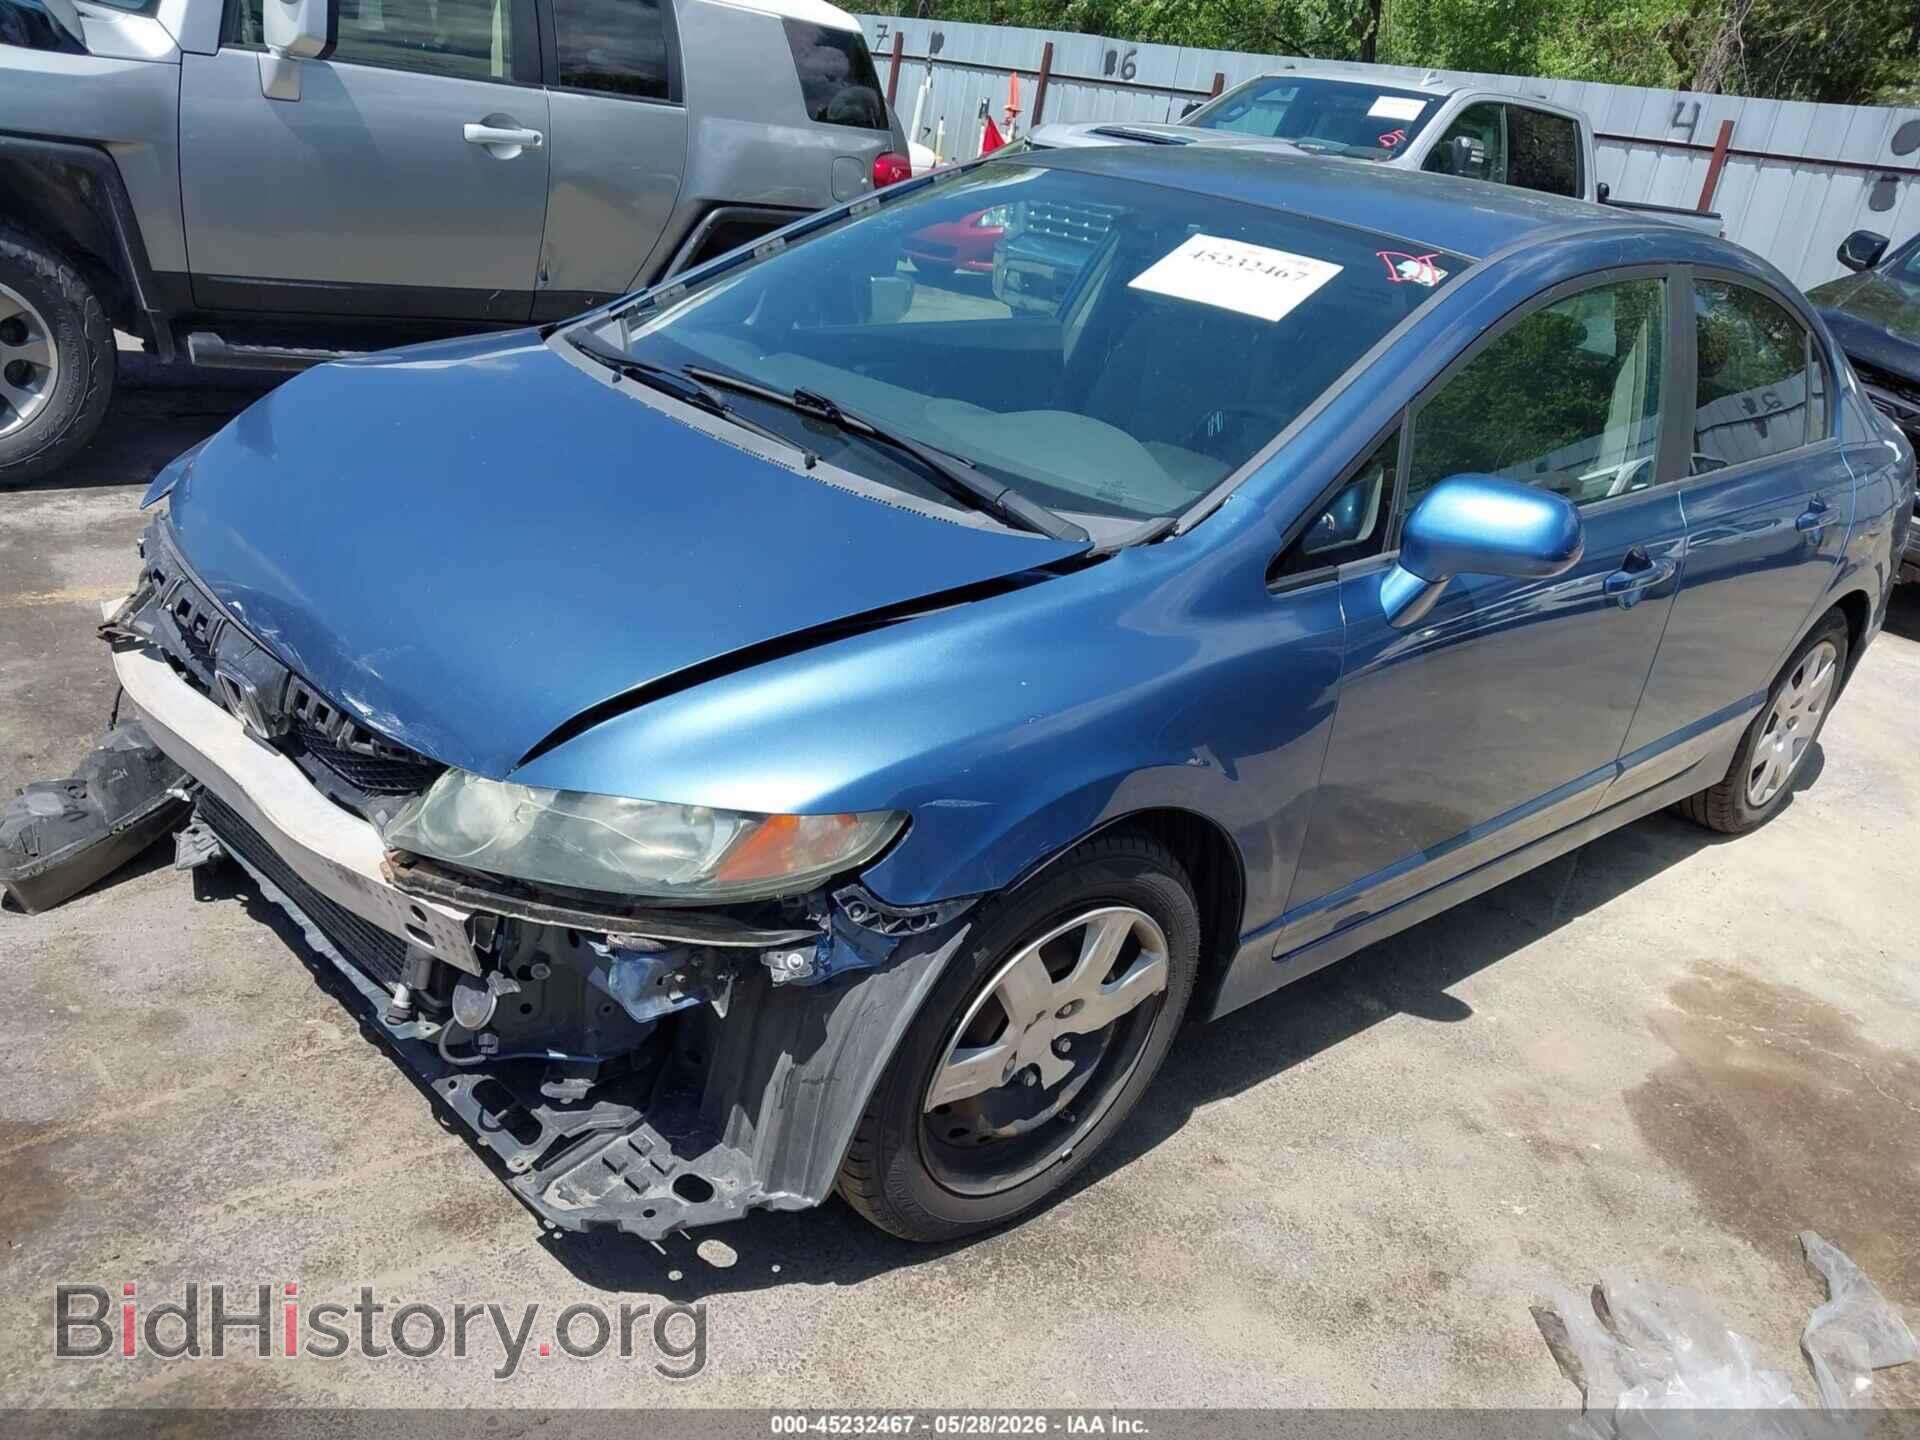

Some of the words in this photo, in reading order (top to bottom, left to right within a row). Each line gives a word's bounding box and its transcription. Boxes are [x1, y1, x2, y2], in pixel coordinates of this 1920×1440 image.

[875, 24, 889, 52] 7
[1120, 49, 1138, 81] 6
[1671, 101, 1701, 144] 4
